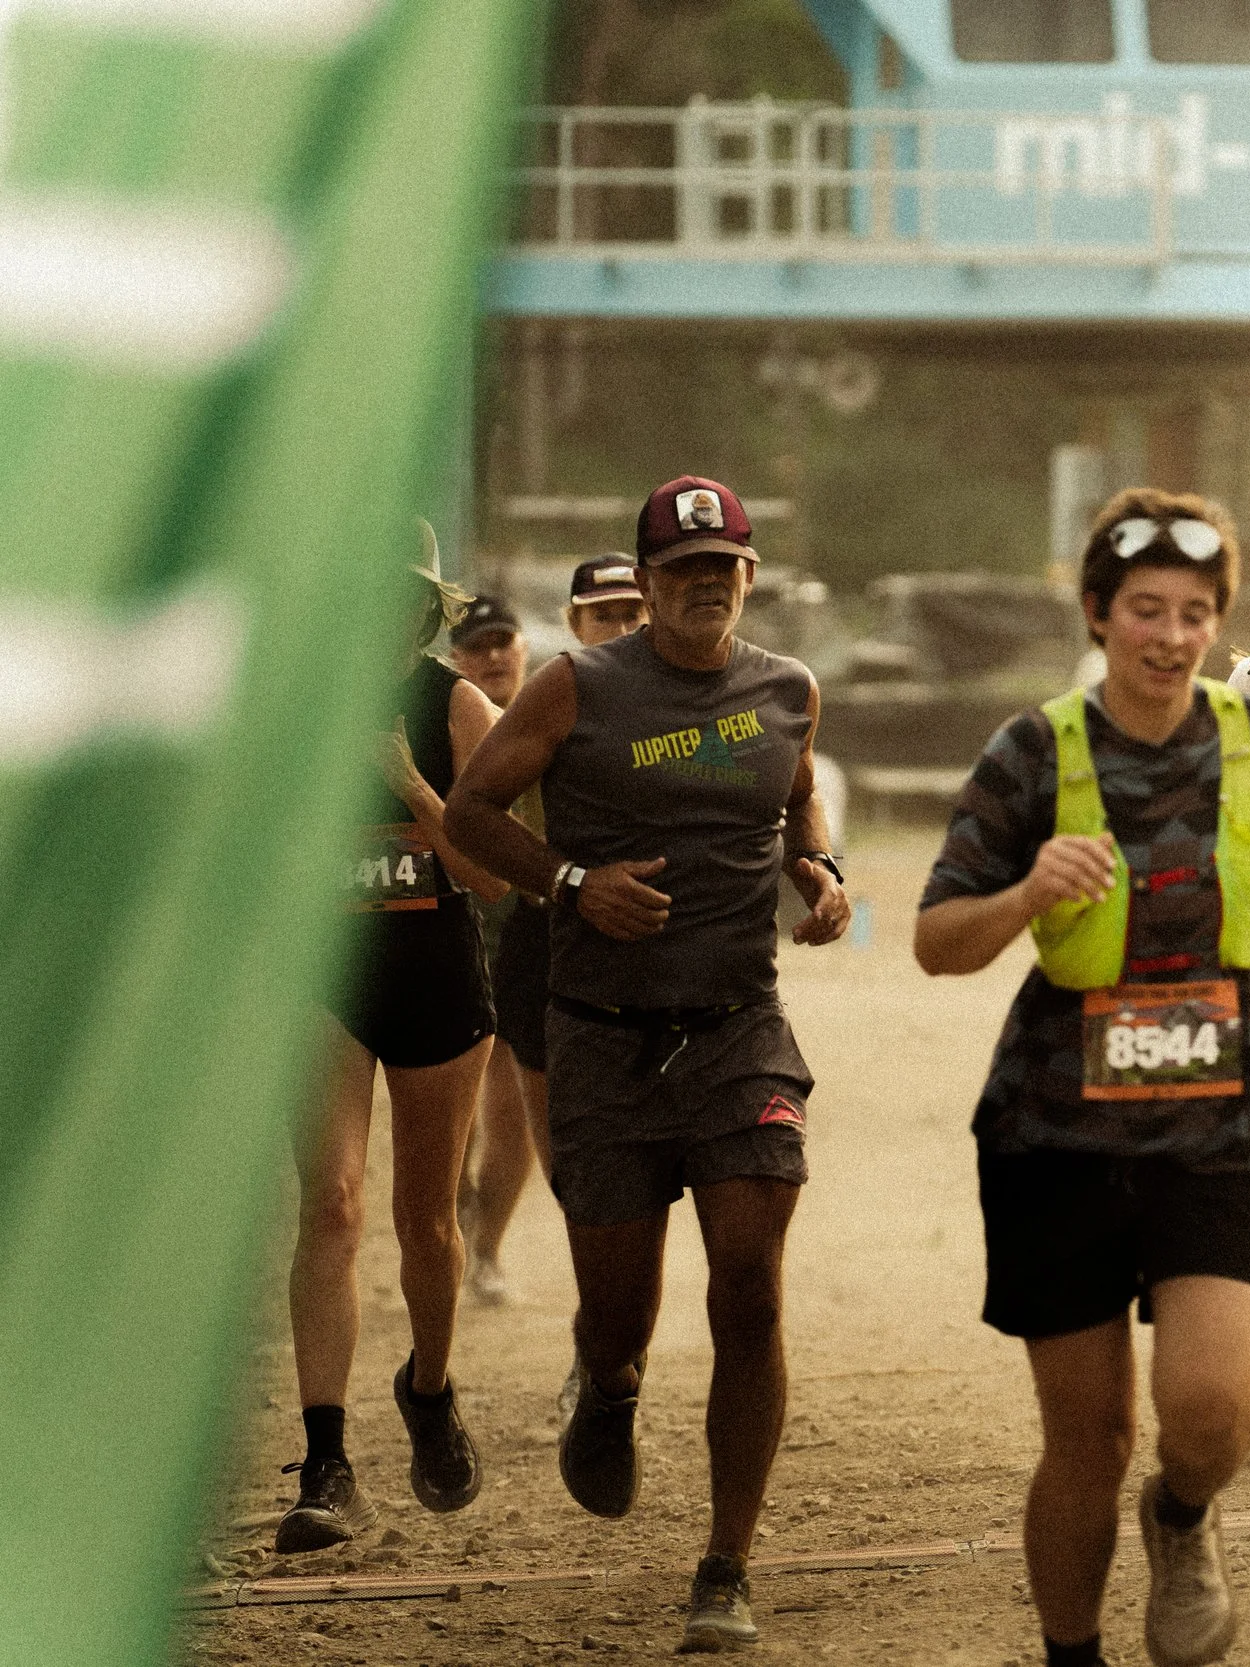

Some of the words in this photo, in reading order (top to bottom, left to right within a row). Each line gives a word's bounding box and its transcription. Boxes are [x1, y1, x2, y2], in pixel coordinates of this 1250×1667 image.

[631, 727, 701, 768] JUPITER
[716, 709, 765, 744] PEAK
[1105, 1022, 1220, 1069] 8544
